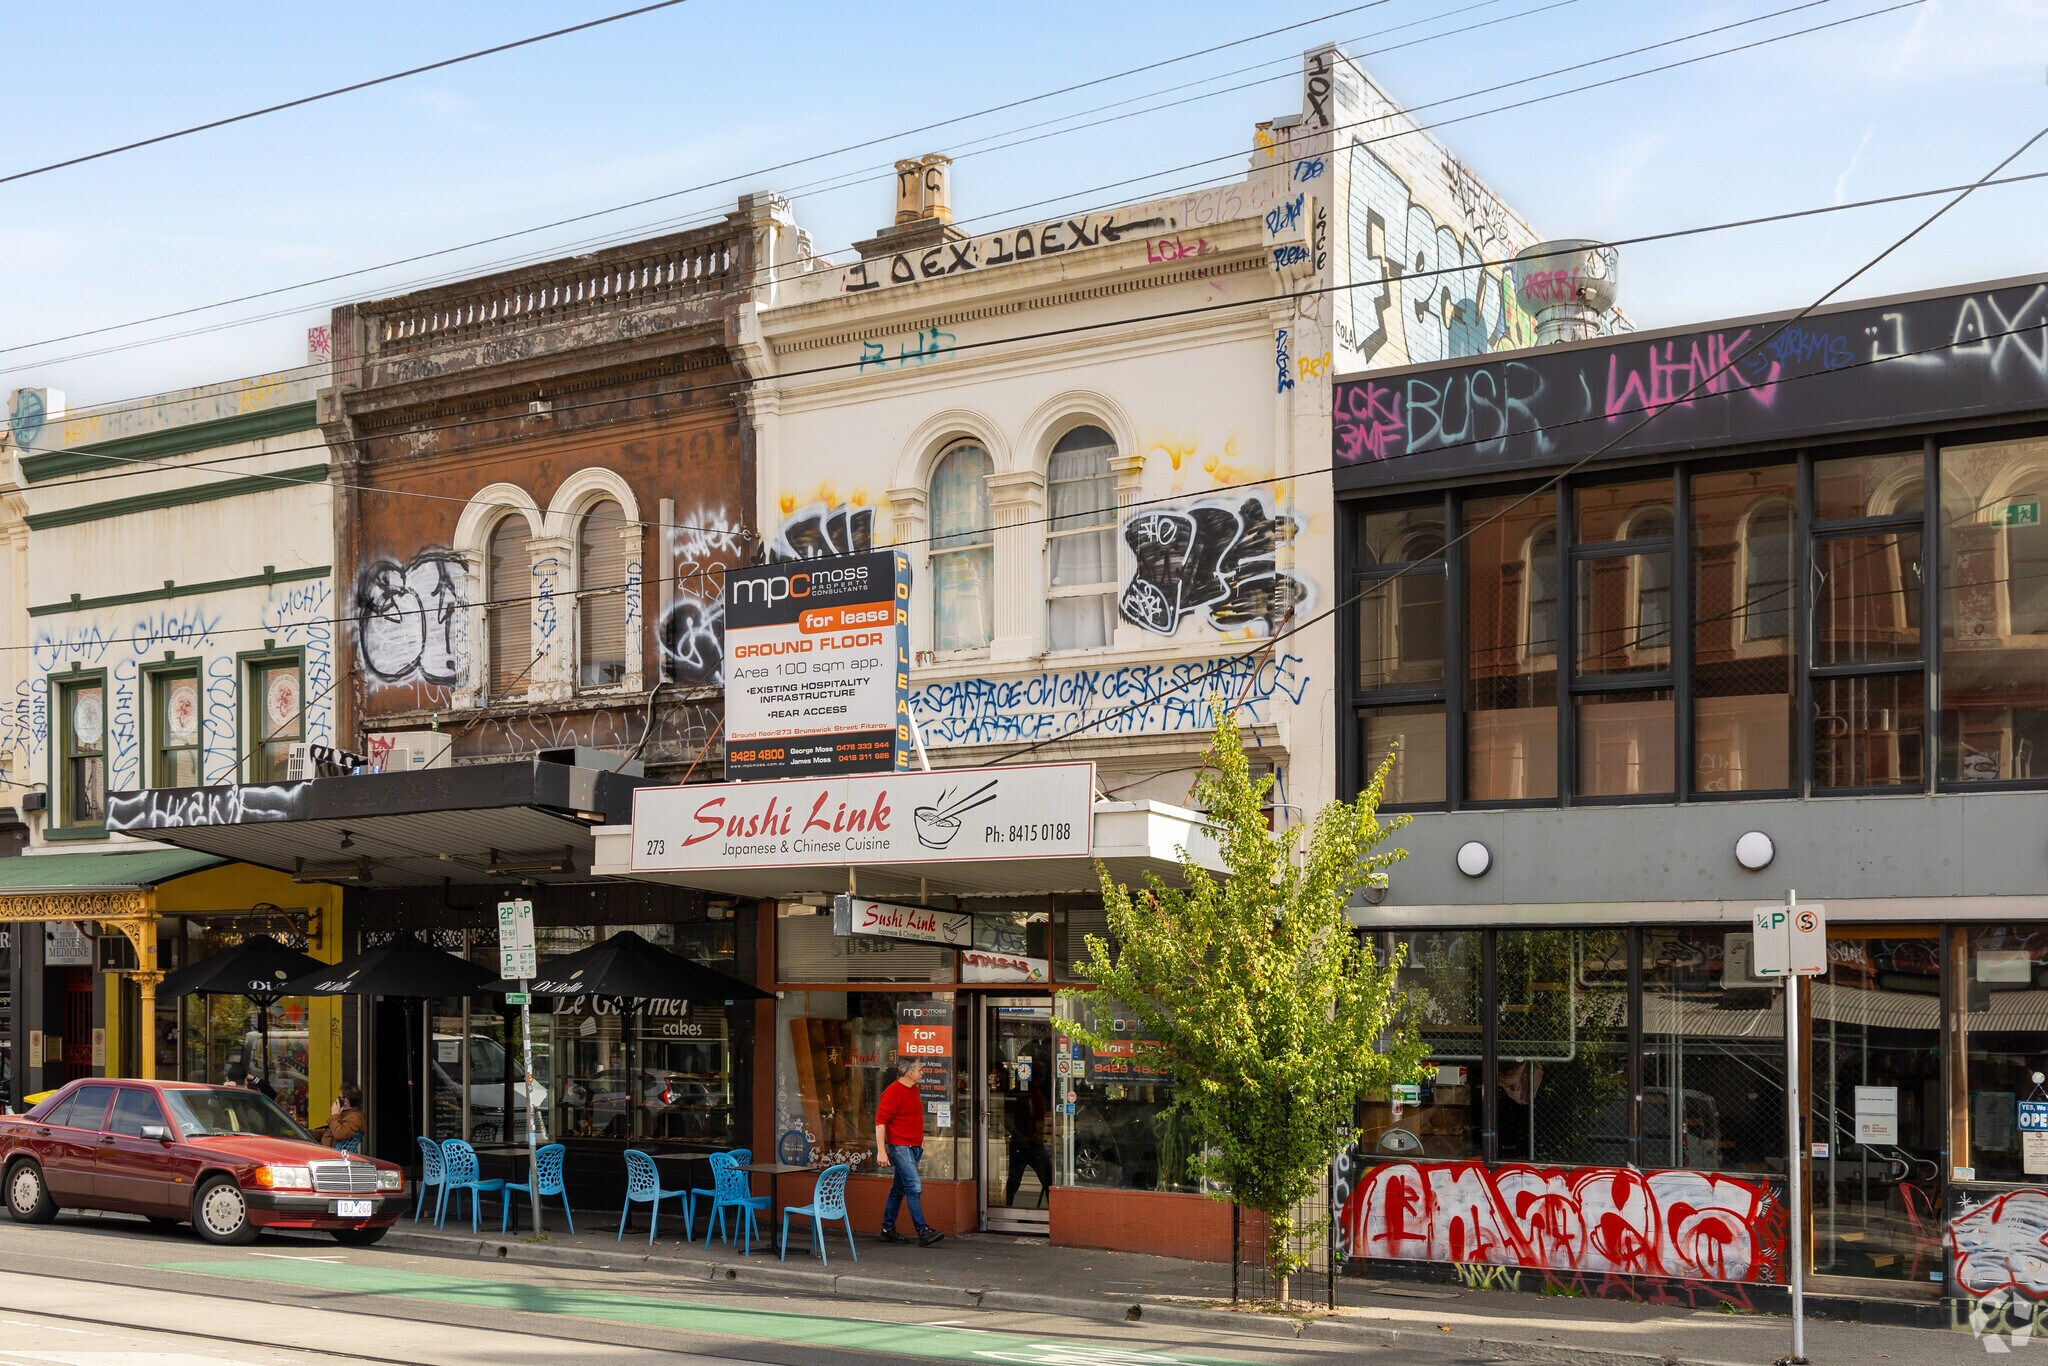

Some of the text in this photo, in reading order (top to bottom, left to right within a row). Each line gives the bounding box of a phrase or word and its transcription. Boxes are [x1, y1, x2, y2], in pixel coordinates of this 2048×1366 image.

[733, 566, 868, 609] mpc moss
[811, 579, 868, 591] PROPERTY
[811, 584, 868, 597] CONSULTANTS
[805, 609, 889, 629] for lease
[734, 632, 883, 659] GROUND FLOOR
[733, 656, 884, 680] Area 100 sqm app.
[896, 556, 910, 768] FOR LEASE
[750, 677, 871, 695] EXISTING HOSPITALITY
[760, 688, 856, 704] INFRASTRUCTURE
[771, 705, 847, 719] REAR ACCESS
[731, 731, 757, 739] Ground
[794, 726, 832, 735] Brunswick
[834, 723, 858, 732] Street
[860, 722, 888, 732] Fitzroy
[730, 748, 785, 762] 9429 4800
[790, 747, 814, 755] George
[836, 743, 856, 751] 0478
[857, 742, 873, 750] 333
[790, 757, 811, 765] James
[813, 756, 832, 764] Moss
[859, 753, 872, 761] 311
[681, 790, 892, 847] Sushi Link
[984, 822, 1071, 844] Ph: 8415 0188
[646, 838, 666, 856] 273
[722, 836, 890, 858] Japanese & Chinese Cuisine
[499, 906, 514, 920] 2P
[862, 904, 937, 933] Sushi Link
[1801, 913, 1814, 930] S
[877, 927, 899, 937] Japanese
[903, 930, 920, 940] Chinese
[920, 932, 936, 941] Cuisine
[51, 937, 87, 948] CHINESE
[49, 947, 90, 958] MEDICINE
[505, 953, 513, 966] P
[552, 994, 689, 1016] Le Gormet
[928, 1007, 947, 1015] moss
[662, 1019, 703, 1036] cakes
[913, 1028, 936, 1040] for
[905, 1041, 944, 1054] lease
[845, 1047, 881, 1066] Sushi
[1094, 1063, 1129, 1074] 9429
[2021, 1104, 2036, 1112] YES,
[2020, 1111, 2048, 1128] OPE
